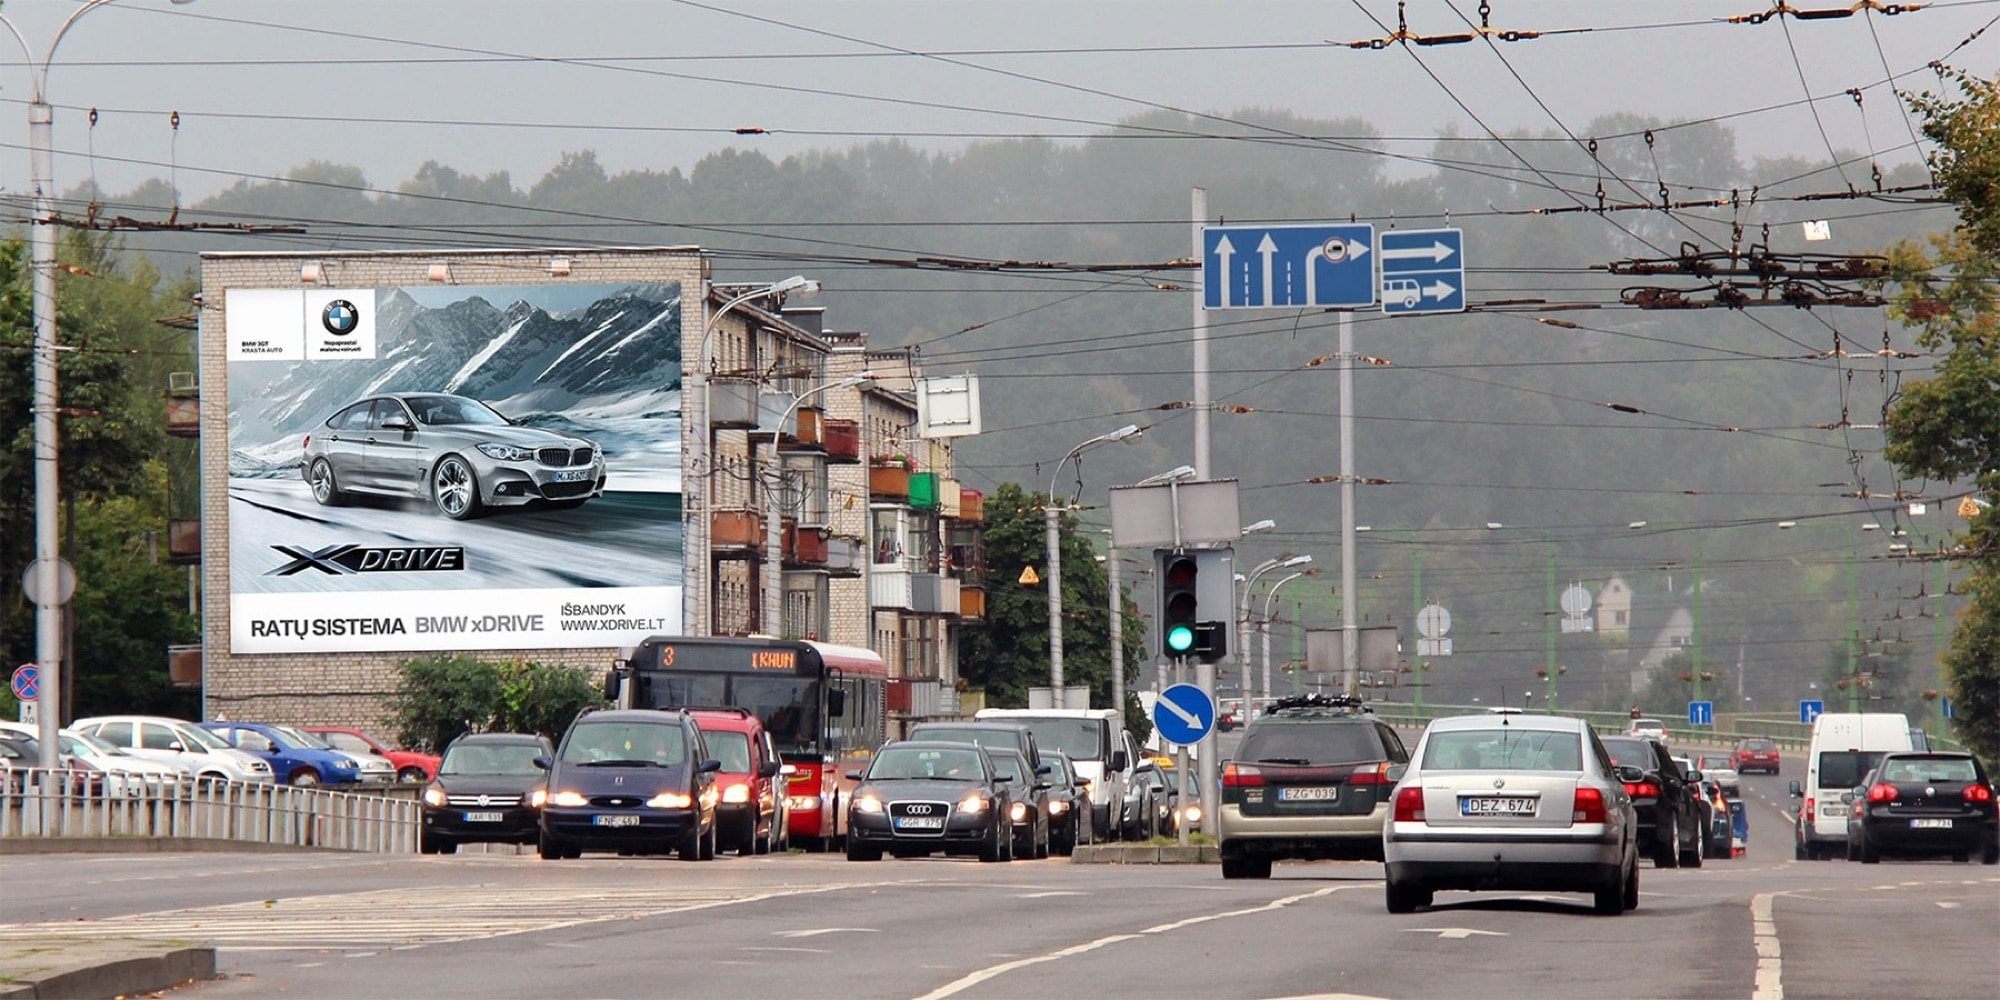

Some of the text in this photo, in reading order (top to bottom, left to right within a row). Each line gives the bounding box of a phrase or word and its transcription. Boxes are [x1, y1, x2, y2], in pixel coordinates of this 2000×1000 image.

[560, 602, 626, 616] IŠBANDYK
[251, 614, 544, 640] RATŲ SISTEMA BMW xDRIVE
[560, 618, 666, 632] WWW.XDRIVE.LT
[663, 646, 674, 666] 3
[1284, 788, 1335, 799] EZG 039
[1470, 799, 1533, 811] DEZ 674
